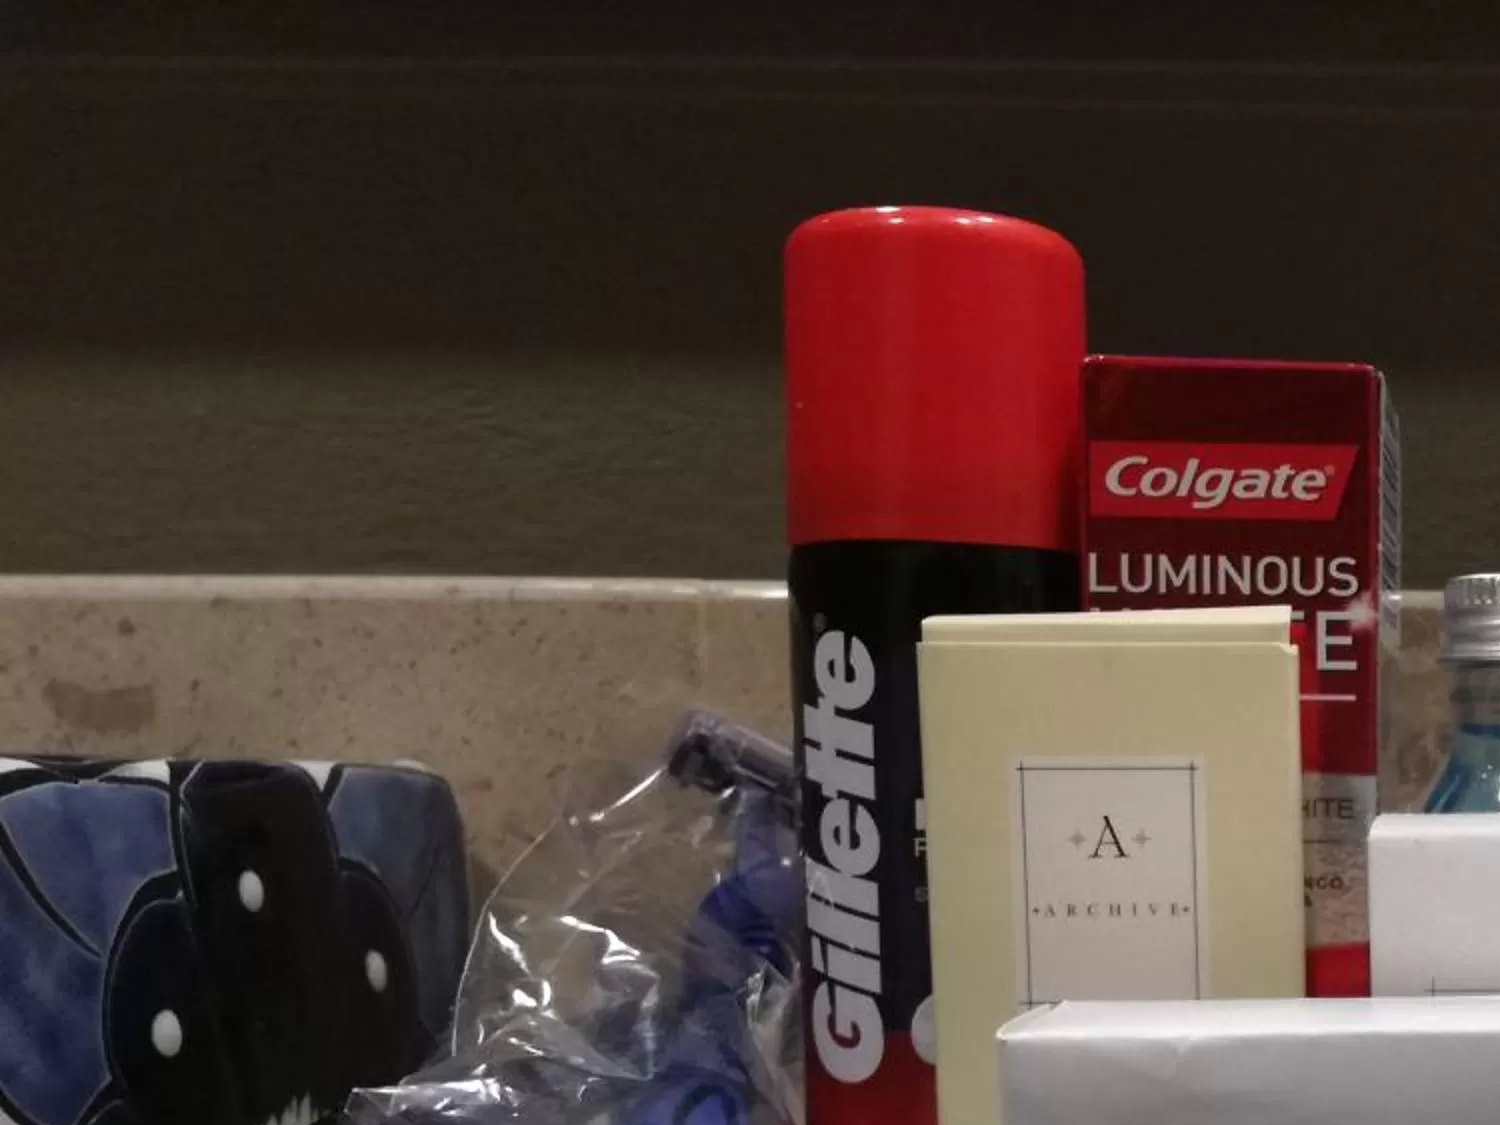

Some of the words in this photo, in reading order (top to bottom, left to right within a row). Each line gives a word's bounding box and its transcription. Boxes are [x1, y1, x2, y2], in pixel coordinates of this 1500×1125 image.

[1104, 455, 1328, 510] Colgate
[1087, 552, 1360, 598] LUMINOUS
[803, 629, 886, 1084] Gillette
[1086, 814, 1132, 860] A
[1043, 902, 1182, 919] ARCHIVE
